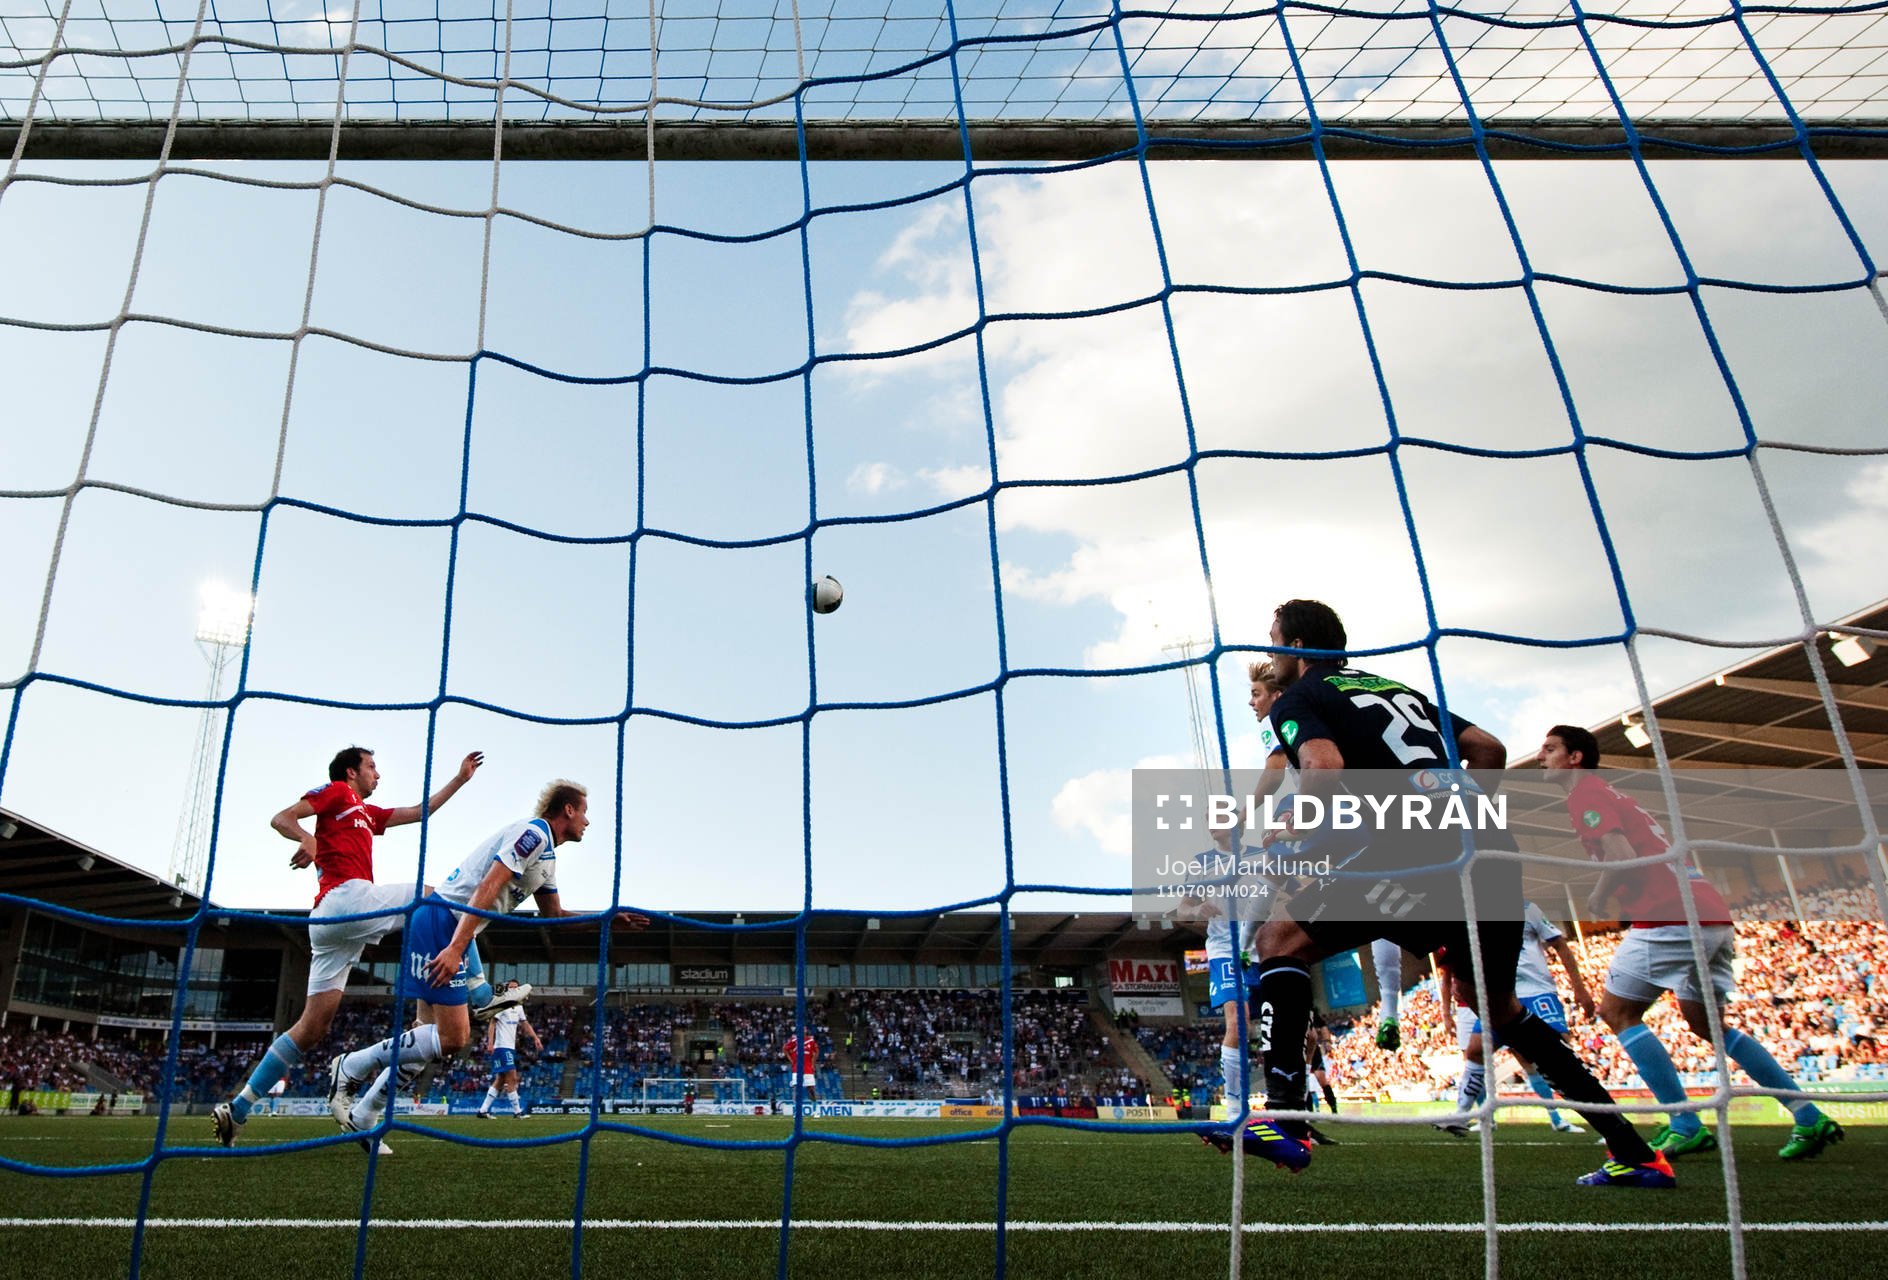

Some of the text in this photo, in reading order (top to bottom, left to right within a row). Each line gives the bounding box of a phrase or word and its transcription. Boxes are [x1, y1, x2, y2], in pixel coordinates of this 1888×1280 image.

[680, 969, 729, 980] stadium
[1109, 959, 1179, 983] MAXI
[531, 1106, 563, 1114] stadium
[950, 1108, 1004, 1116] office offic
